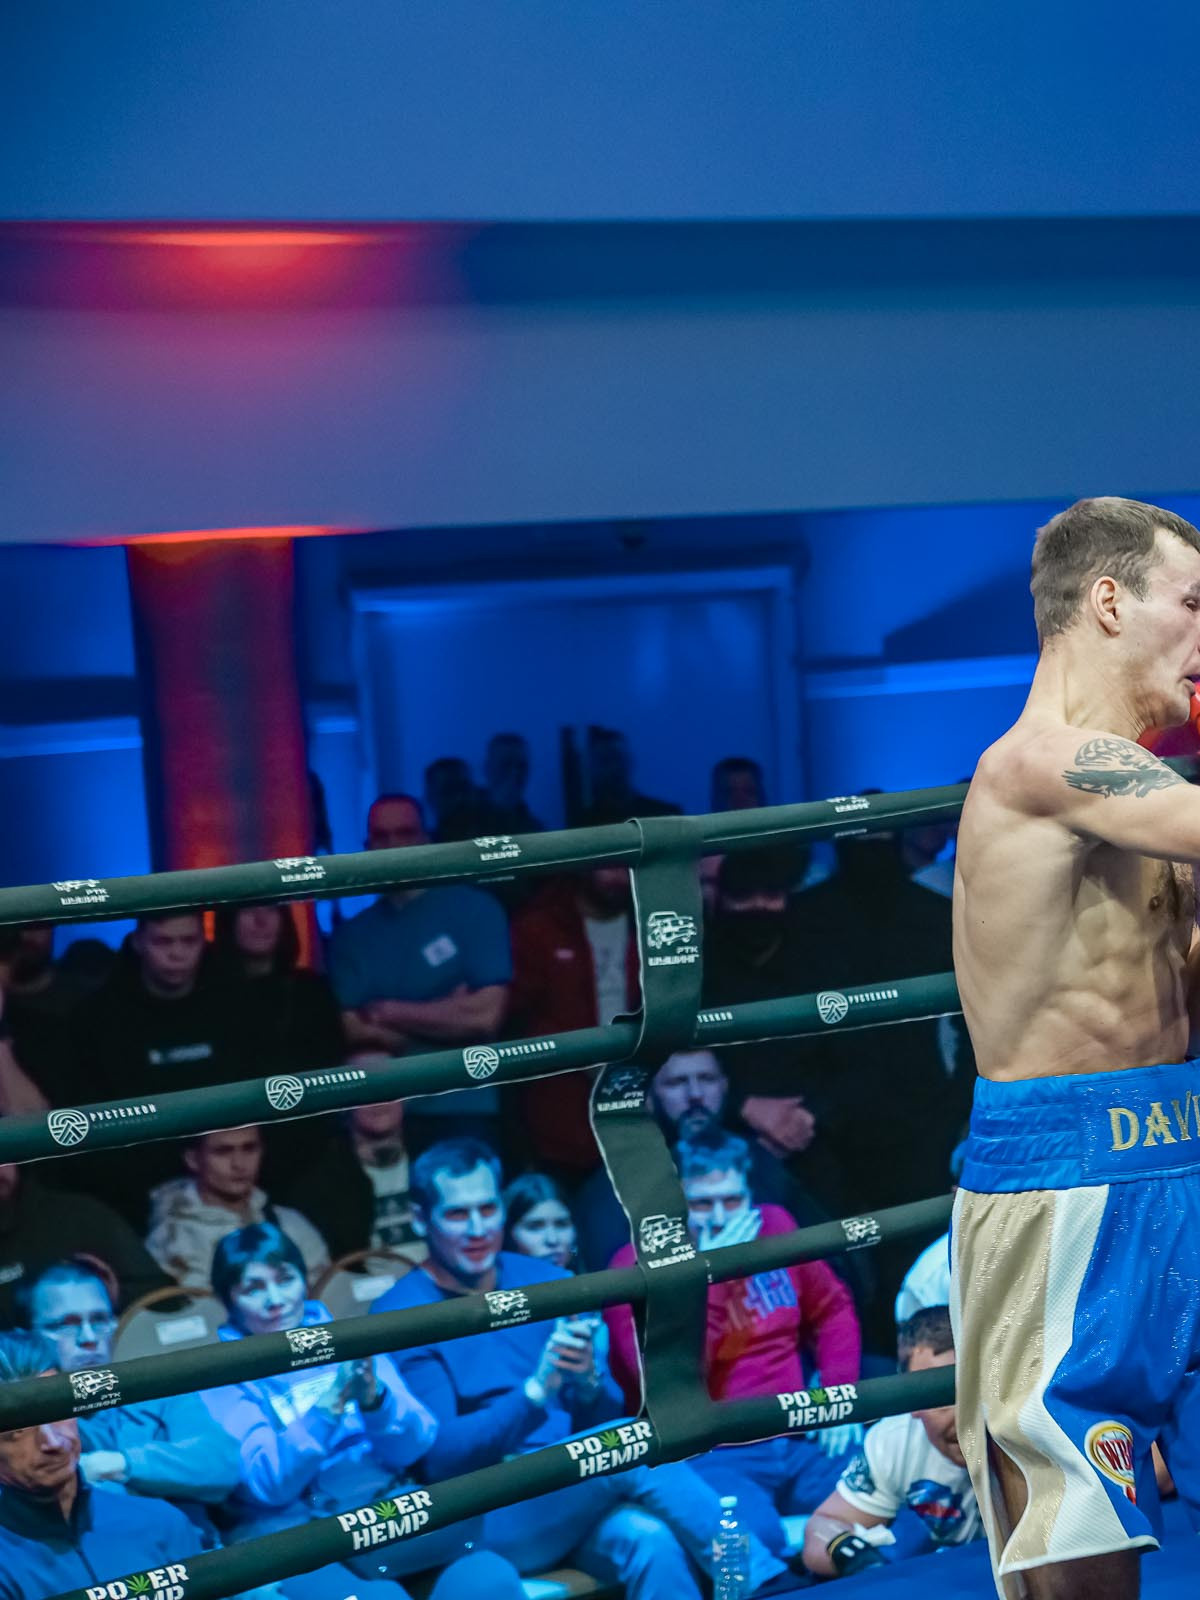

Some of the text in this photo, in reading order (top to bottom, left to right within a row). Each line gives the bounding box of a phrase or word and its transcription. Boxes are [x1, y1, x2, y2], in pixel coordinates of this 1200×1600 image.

[89, 1103, 158, 1122] РУСТЕХКОН
[788, 1402, 855, 1428] HEMP
[579, 1441, 650, 1478] HEMP
[352, 1509, 431, 1551] HEMP
